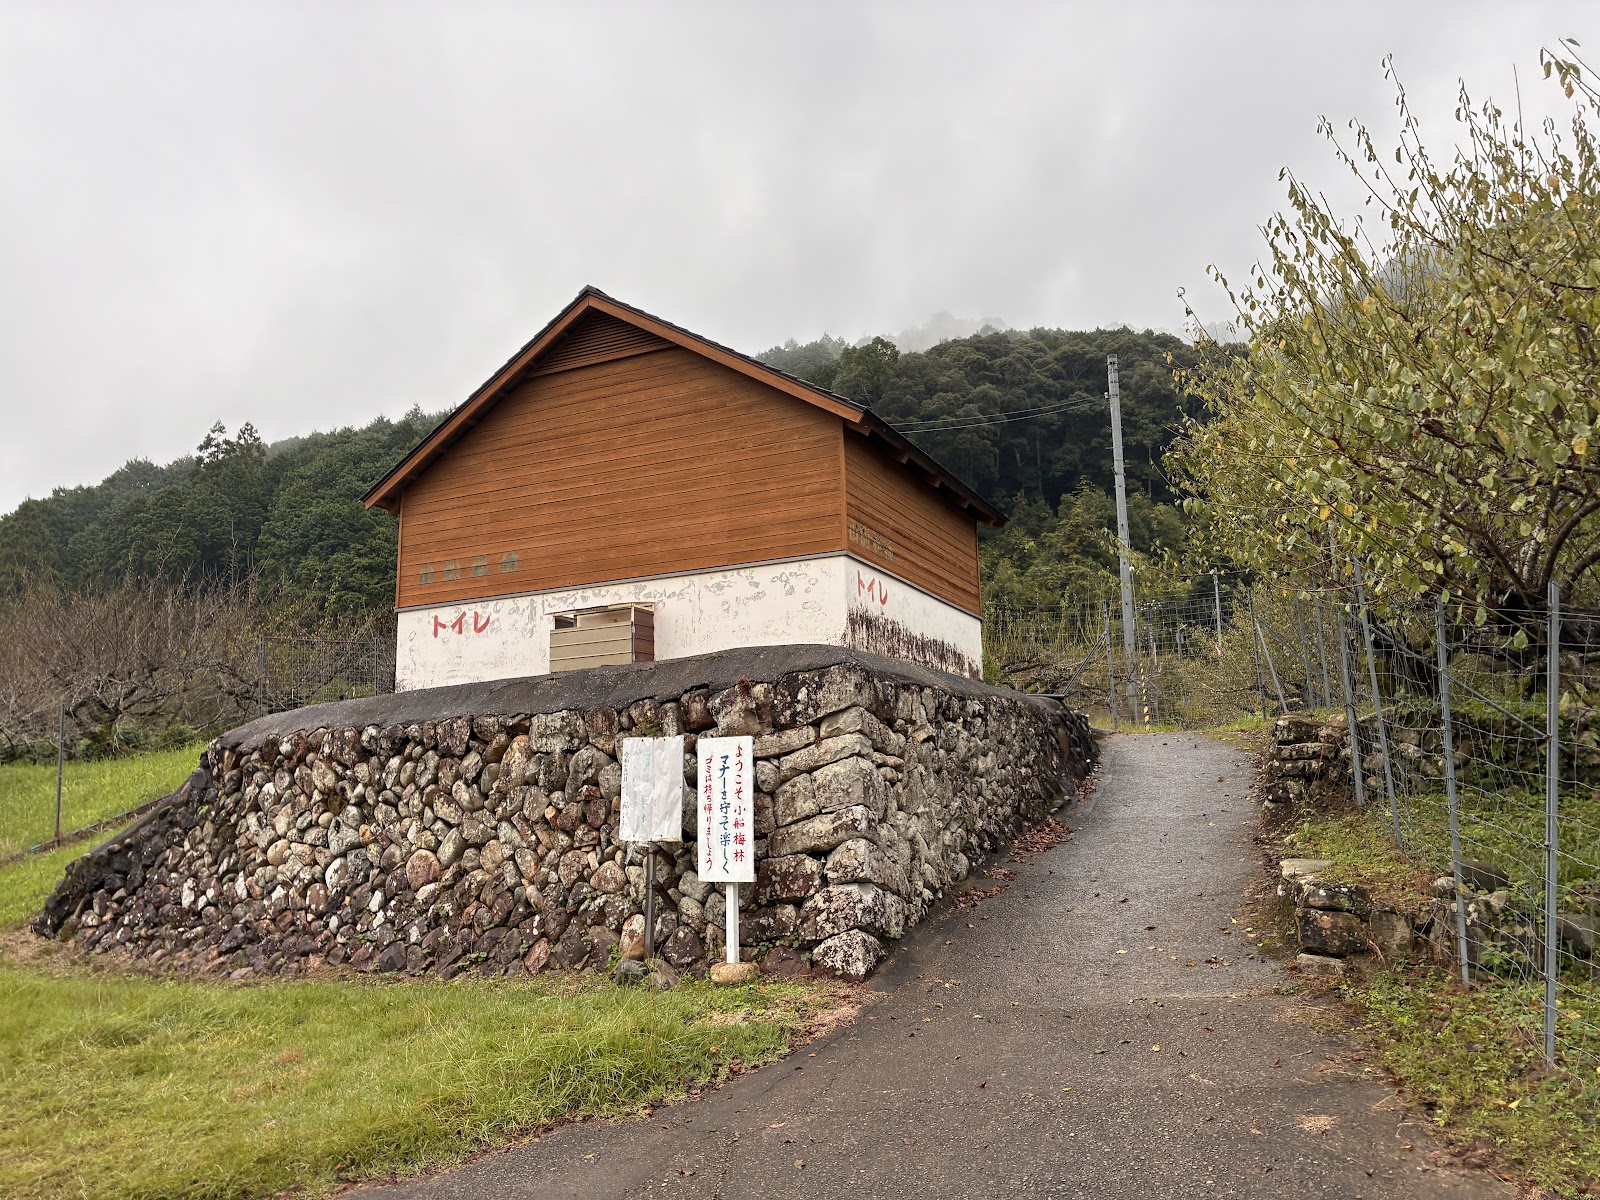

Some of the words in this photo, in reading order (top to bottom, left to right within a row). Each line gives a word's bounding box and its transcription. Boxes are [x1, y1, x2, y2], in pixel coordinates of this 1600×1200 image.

[433, 610, 491, 639] トイレ
[857, 569, 888, 606] トイレ
[703, 755, 713, 873] ゴミは持ち帰りましょう
[718, 754, 731, 874] マナーを守って楽しく
